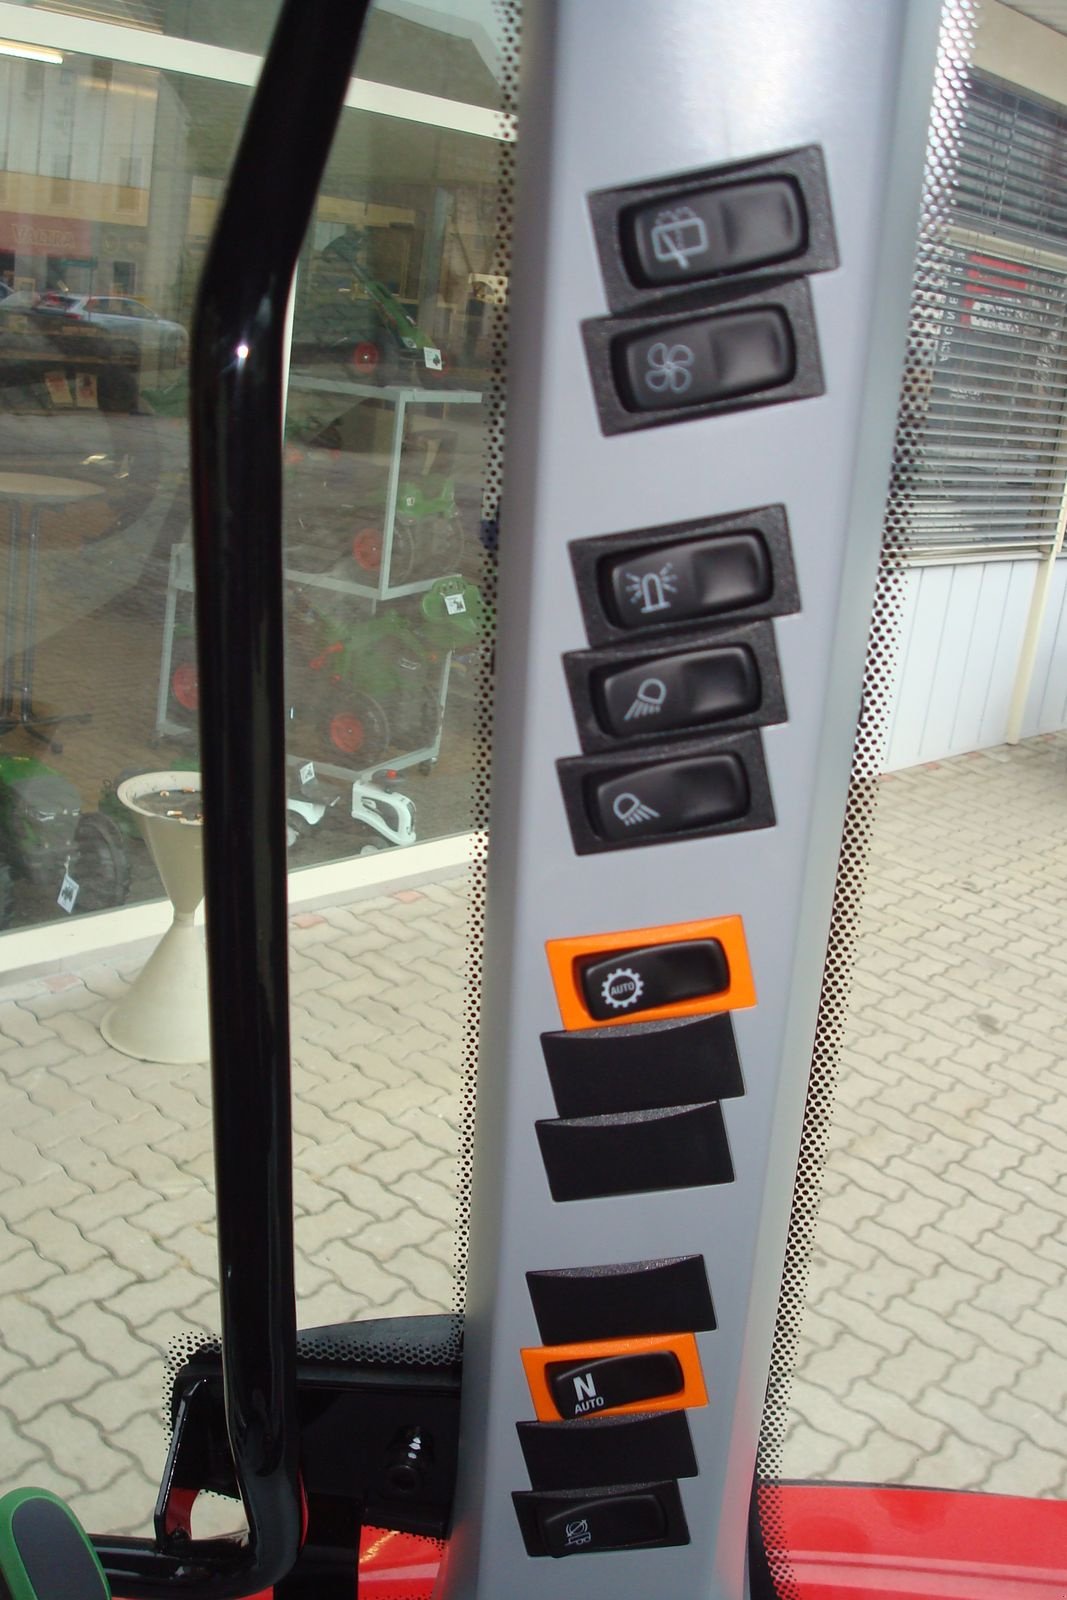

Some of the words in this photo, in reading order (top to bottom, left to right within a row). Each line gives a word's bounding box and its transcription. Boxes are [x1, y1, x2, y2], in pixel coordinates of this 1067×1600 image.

[611, 982, 635, 996] AUTO
[573, 1373, 596, 1401] N
[575, 1396, 604, 1414] AUTO
